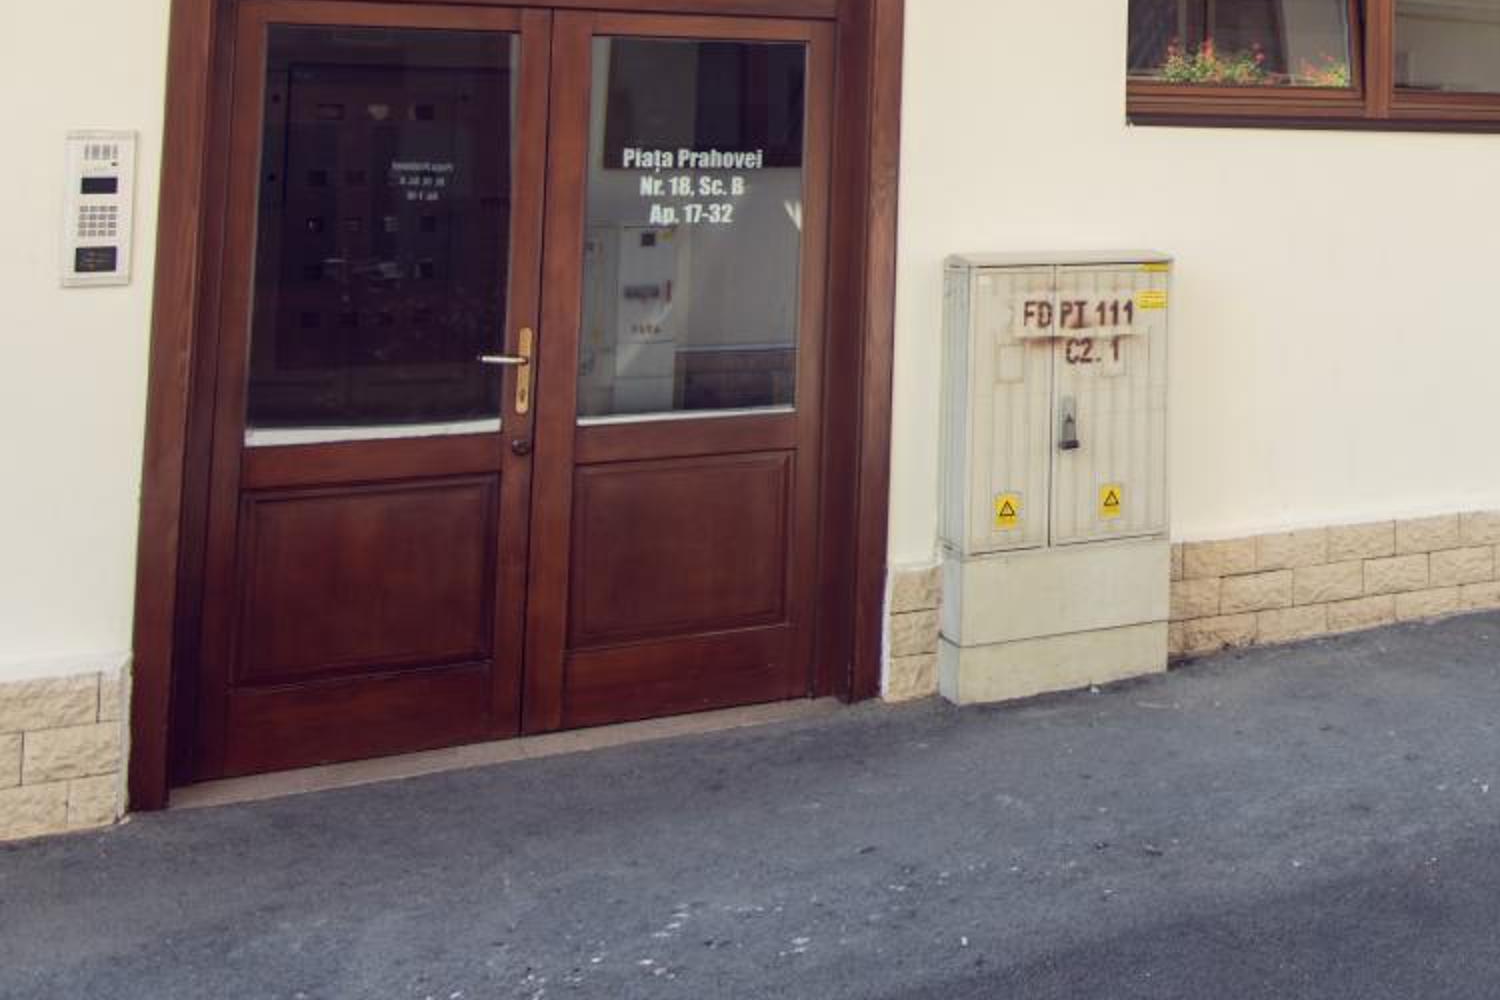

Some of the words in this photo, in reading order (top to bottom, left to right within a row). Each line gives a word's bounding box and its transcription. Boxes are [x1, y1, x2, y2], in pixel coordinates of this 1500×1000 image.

[677, 148, 763, 168] Prahovei
[640, 176, 665, 196] Nr.
[699, 176, 727, 196] Sc.
[731, 176, 745, 195] B
[649, 204, 680, 226] Ap.
[683, 203, 734, 223] 17-32
[1096, 299, 1134, 326] 111
